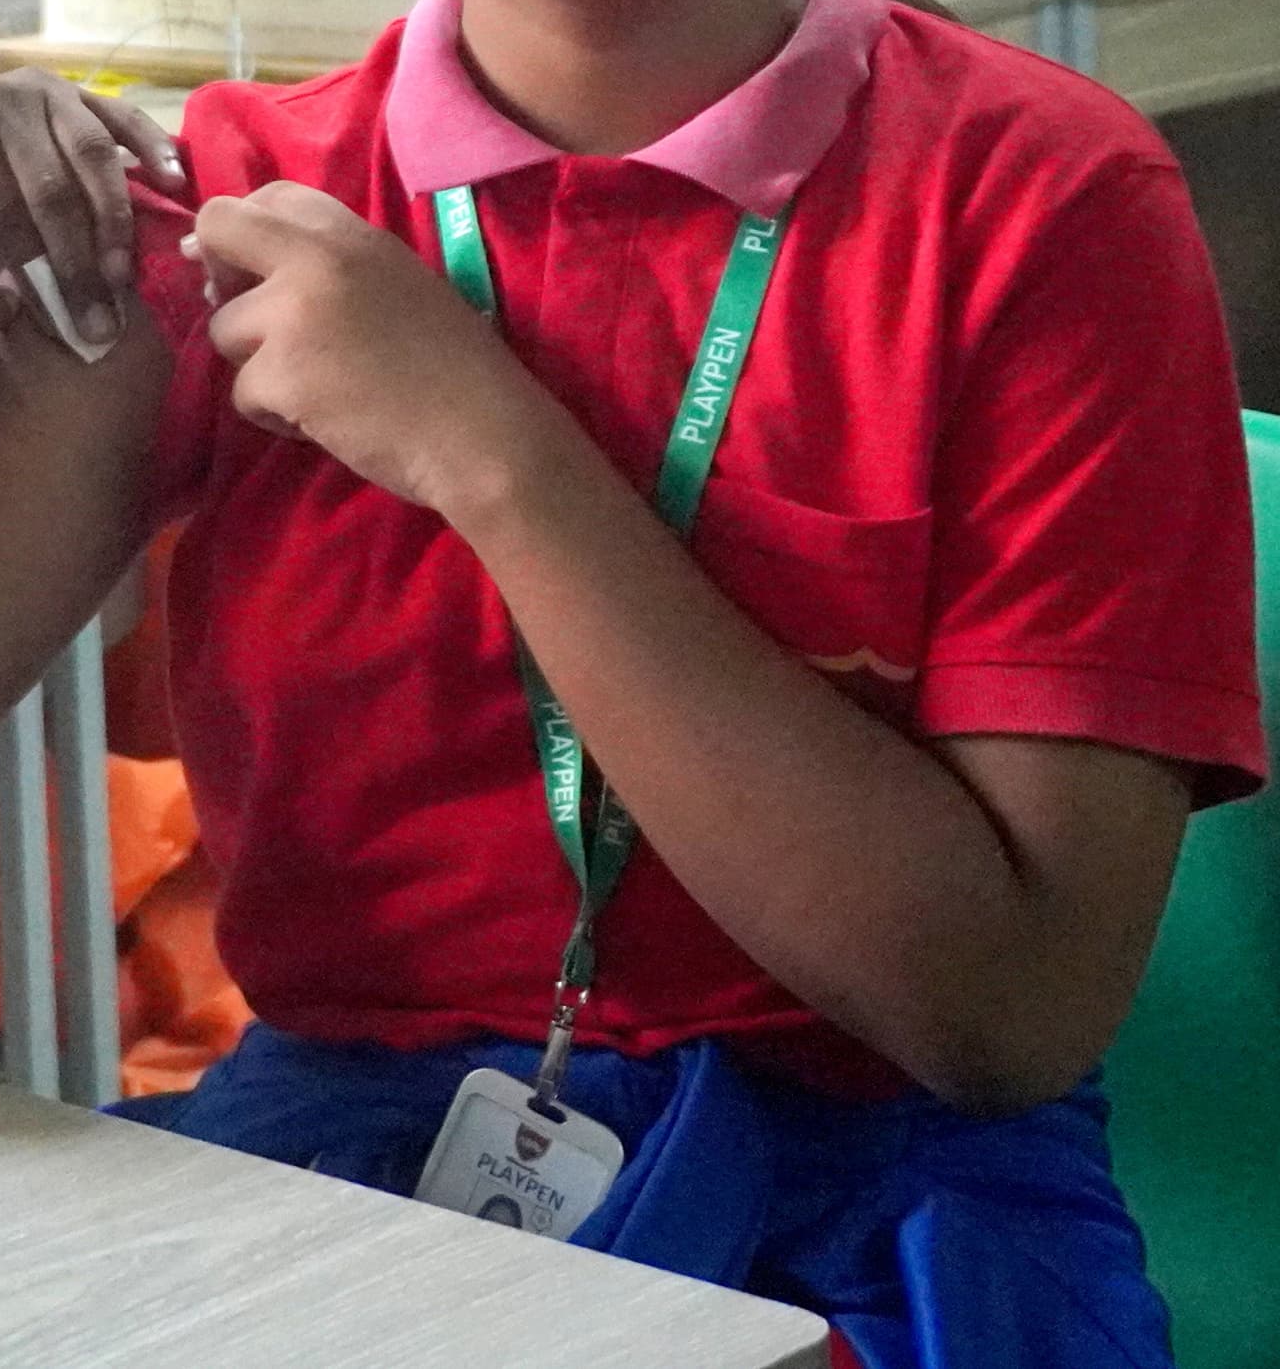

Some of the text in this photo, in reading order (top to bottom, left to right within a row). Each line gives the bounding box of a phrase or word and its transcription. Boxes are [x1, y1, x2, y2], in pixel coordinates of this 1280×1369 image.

[743, 220, 777, 254] PL
[679, 326, 742, 445] PLAYPEN
[476, 1151, 566, 1211] PLAYPEN
